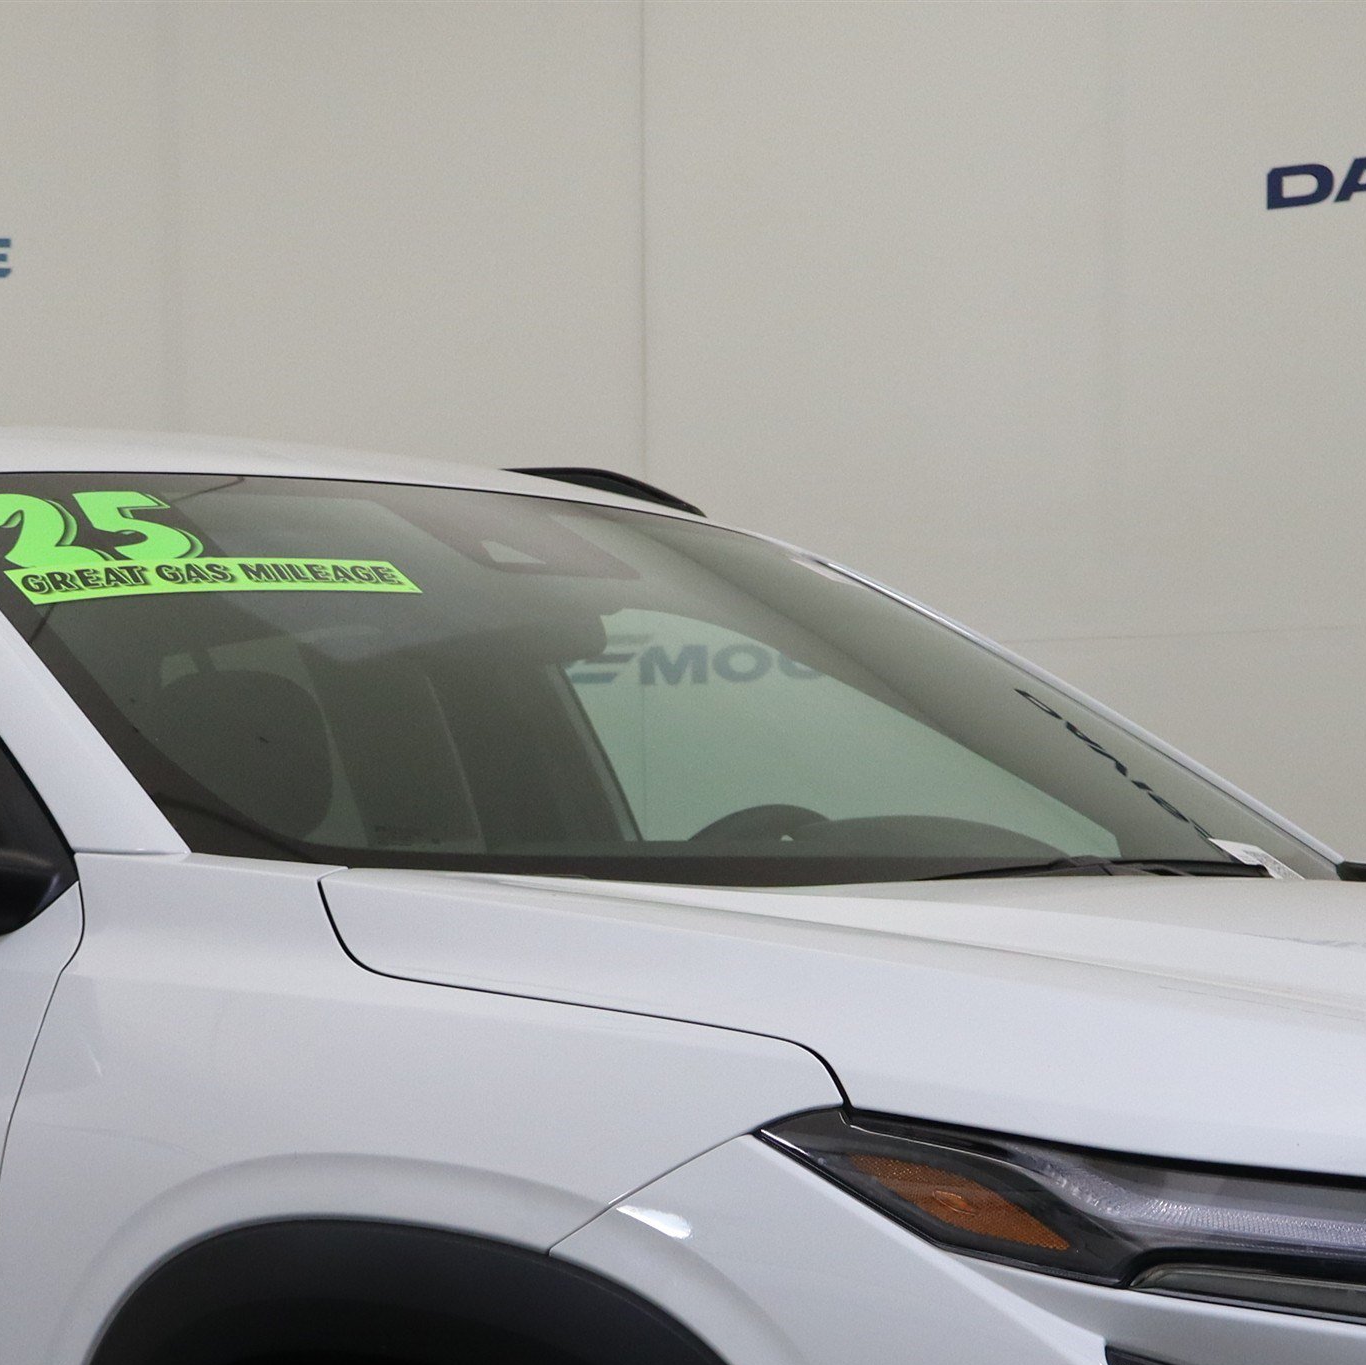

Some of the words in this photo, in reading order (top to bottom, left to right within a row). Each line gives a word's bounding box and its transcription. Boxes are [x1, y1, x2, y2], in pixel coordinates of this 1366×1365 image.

[21, 564, 148, 597] GREAT
[155, 563, 237, 586] GAS
[242, 561, 406, 587] MILEAGE
